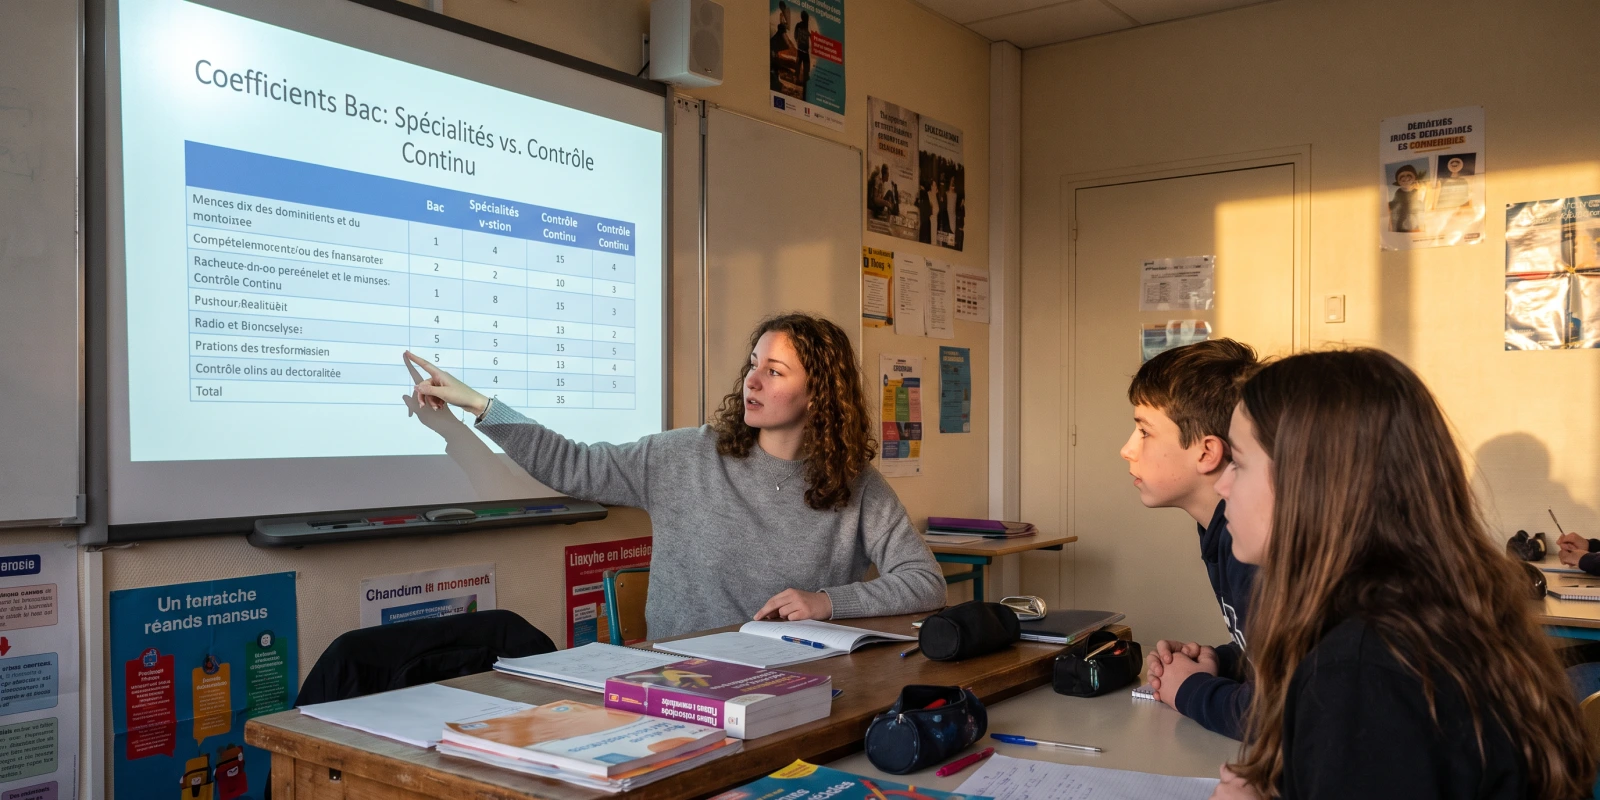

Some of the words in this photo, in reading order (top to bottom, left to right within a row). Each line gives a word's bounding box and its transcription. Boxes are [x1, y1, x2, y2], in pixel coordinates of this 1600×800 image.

[195, 60, 337, 112] Coefficients
[345, 94, 387, 124] Bac:
[395, 106, 494, 148] Spécialités
[499, 136, 522, 155] vs.
[528, 139, 594, 171] Contrôle
[1398, 143, 1408, 151] ES
[402, 142, 475, 176] Continu
[193, 194, 234, 209] Mences
[237, 201, 252, 211] dix
[256, 203, 273, 215] des
[337, 217, 346, 226] et
[349, 217, 360, 227] du
[426, 200, 444, 213] Bac
[469, 200, 519, 218] Spécialités
[541, 213, 578, 228] Contrôle
[597, 223, 631, 237] Contrôle
[543, 228, 576, 243] Continu
[434, 237, 439, 246] 1
[598, 238, 629, 251] Continu
[313, 248, 329, 258] des
[492, 246, 498, 254] 4
[556, 255, 565, 263] 15
[434, 263, 439, 271] 2
[331, 272, 341, 281] et
[343, 272, 351, 282] le
[493, 271, 498, 279] 2
[194, 273, 239, 286] Contrôle
[242, 278, 282, 290] Continu
[556, 279, 565, 287] 10
[434, 289, 439, 297] 1
[493, 296, 498, 304] 8
[556, 302, 565, 310] 15
[195, 318, 225, 329] Radio
[228, 321, 238, 330] et
[434, 315, 439, 324] 4
[493, 321, 498, 329] 4
[556, 326, 565, 334] 13
[435, 335, 439, 343] 5
[493, 339, 498, 347] 5
[195, 341, 238, 352] Prations
[241, 343, 258, 353] des
[556, 344, 565, 352] 15
[435, 354, 439, 362] 5
[493, 357, 498, 365] 6
[195, 363, 241, 375] Contrôle
[244, 366, 268, 375] olins
[556, 361, 565, 369] 13
[493, 376, 498, 384] 4
[196, 386, 222, 396] Total
[556, 396, 565, 404] 35
[607, 551, 618, 561] en
[158, 597, 181, 612] Un
[145, 614, 202, 634] réands
[207, 607, 268, 626] mansus
